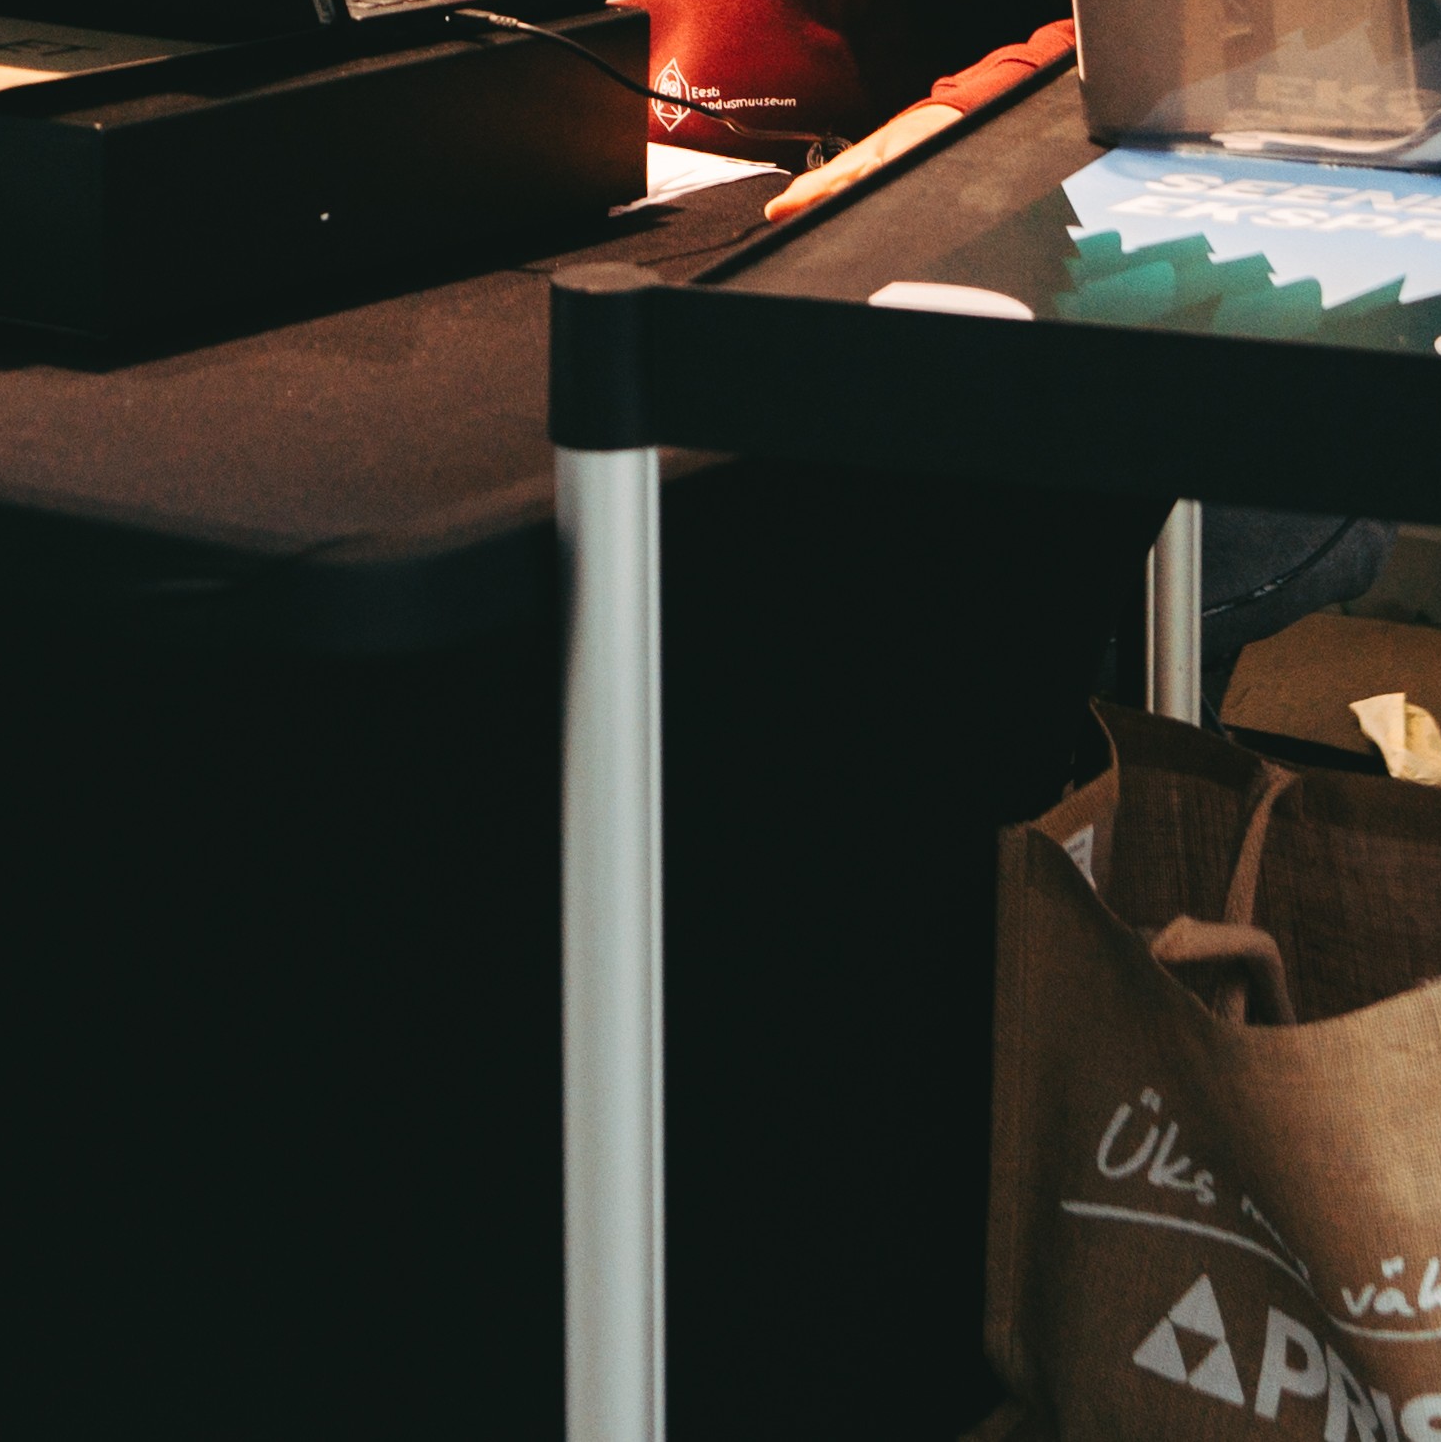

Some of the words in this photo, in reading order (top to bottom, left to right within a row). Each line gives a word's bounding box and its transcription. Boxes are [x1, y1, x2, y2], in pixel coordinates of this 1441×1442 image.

[691, 86, 720, 99] Eesti
[700, 97, 797, 110] oodusmuuseum
[1097, 1088, 1216, 1205] Üks
